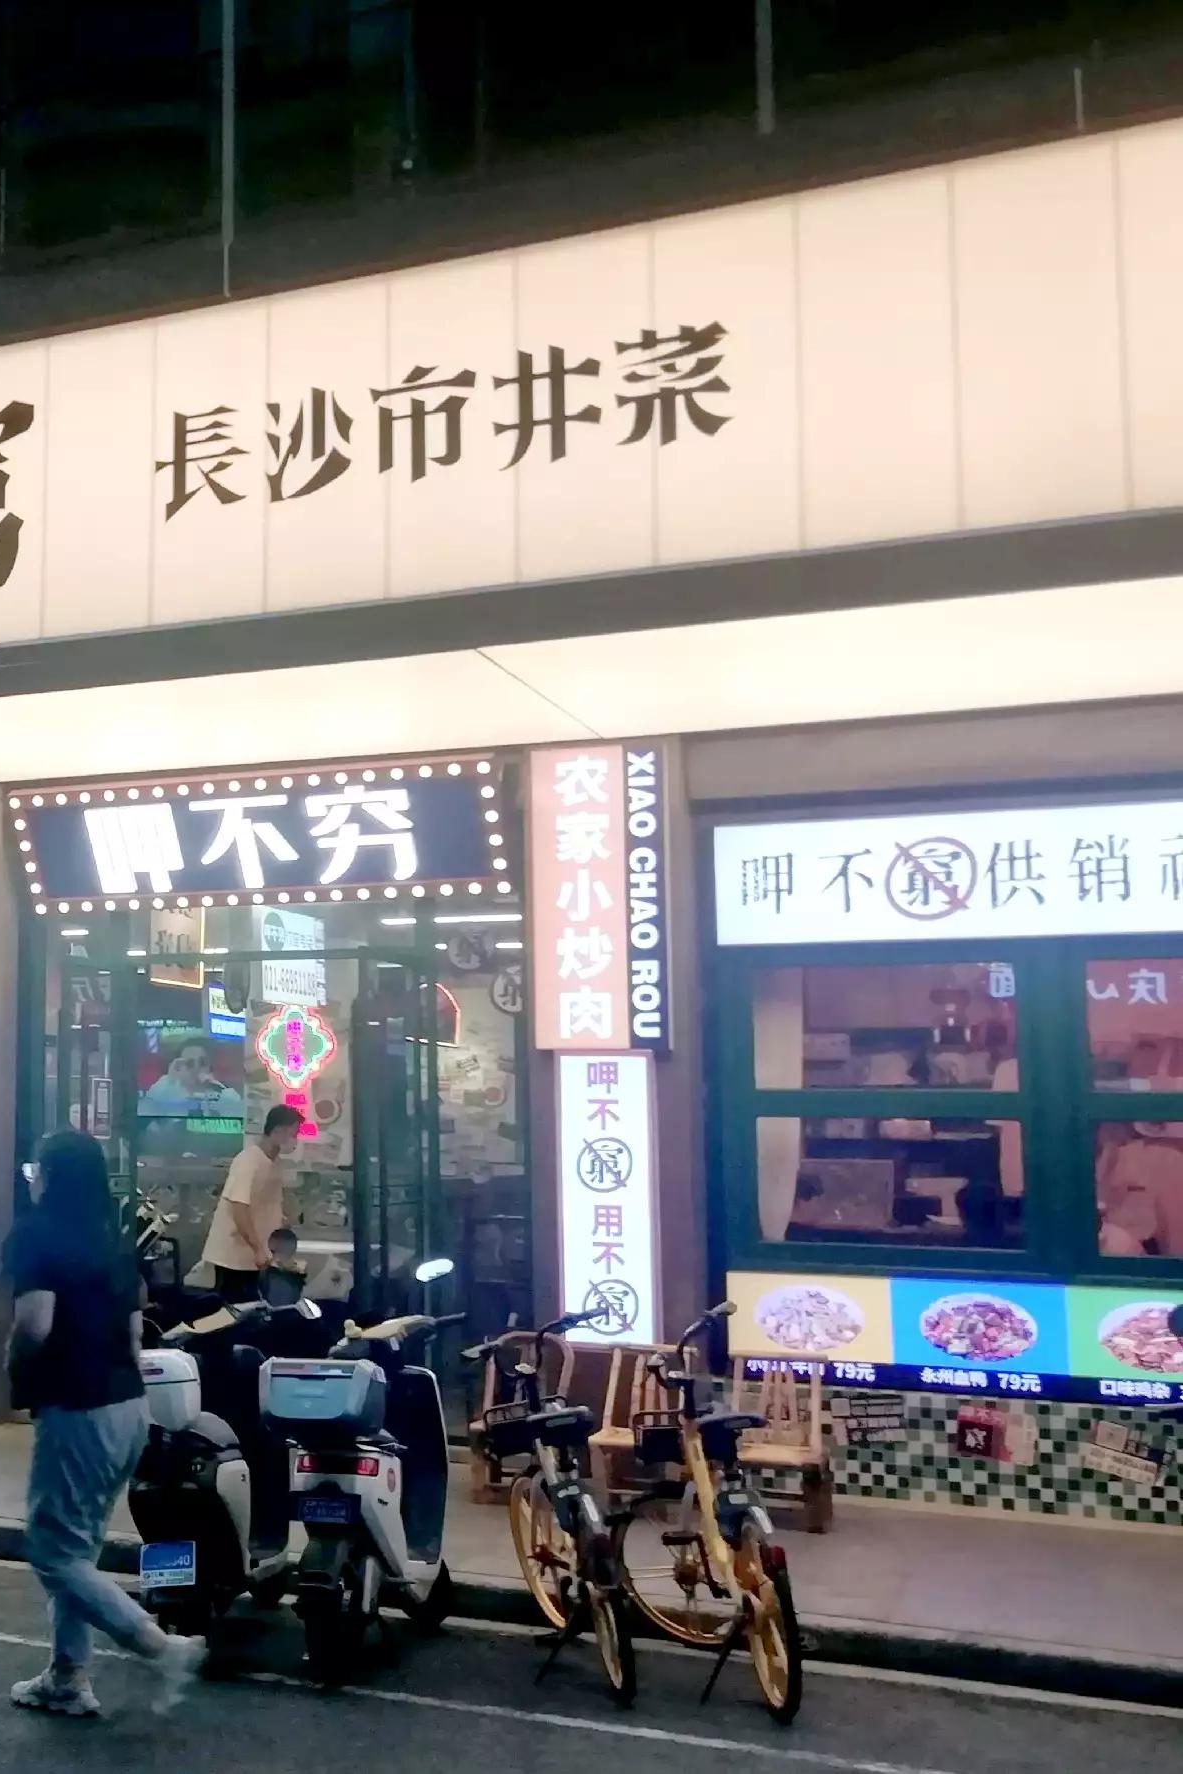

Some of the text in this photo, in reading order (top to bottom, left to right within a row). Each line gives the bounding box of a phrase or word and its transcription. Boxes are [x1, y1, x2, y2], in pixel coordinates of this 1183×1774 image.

[156, 320, 734, 522] 長沙市井菜
[553, 755, 614, 1039] 农家小炒肉
[627, 751, 662, 1038] XIAO CHAO ROU
[833, 1362, 876, 1382] 79元
[997, 1371, 1041, 1394] 79元
